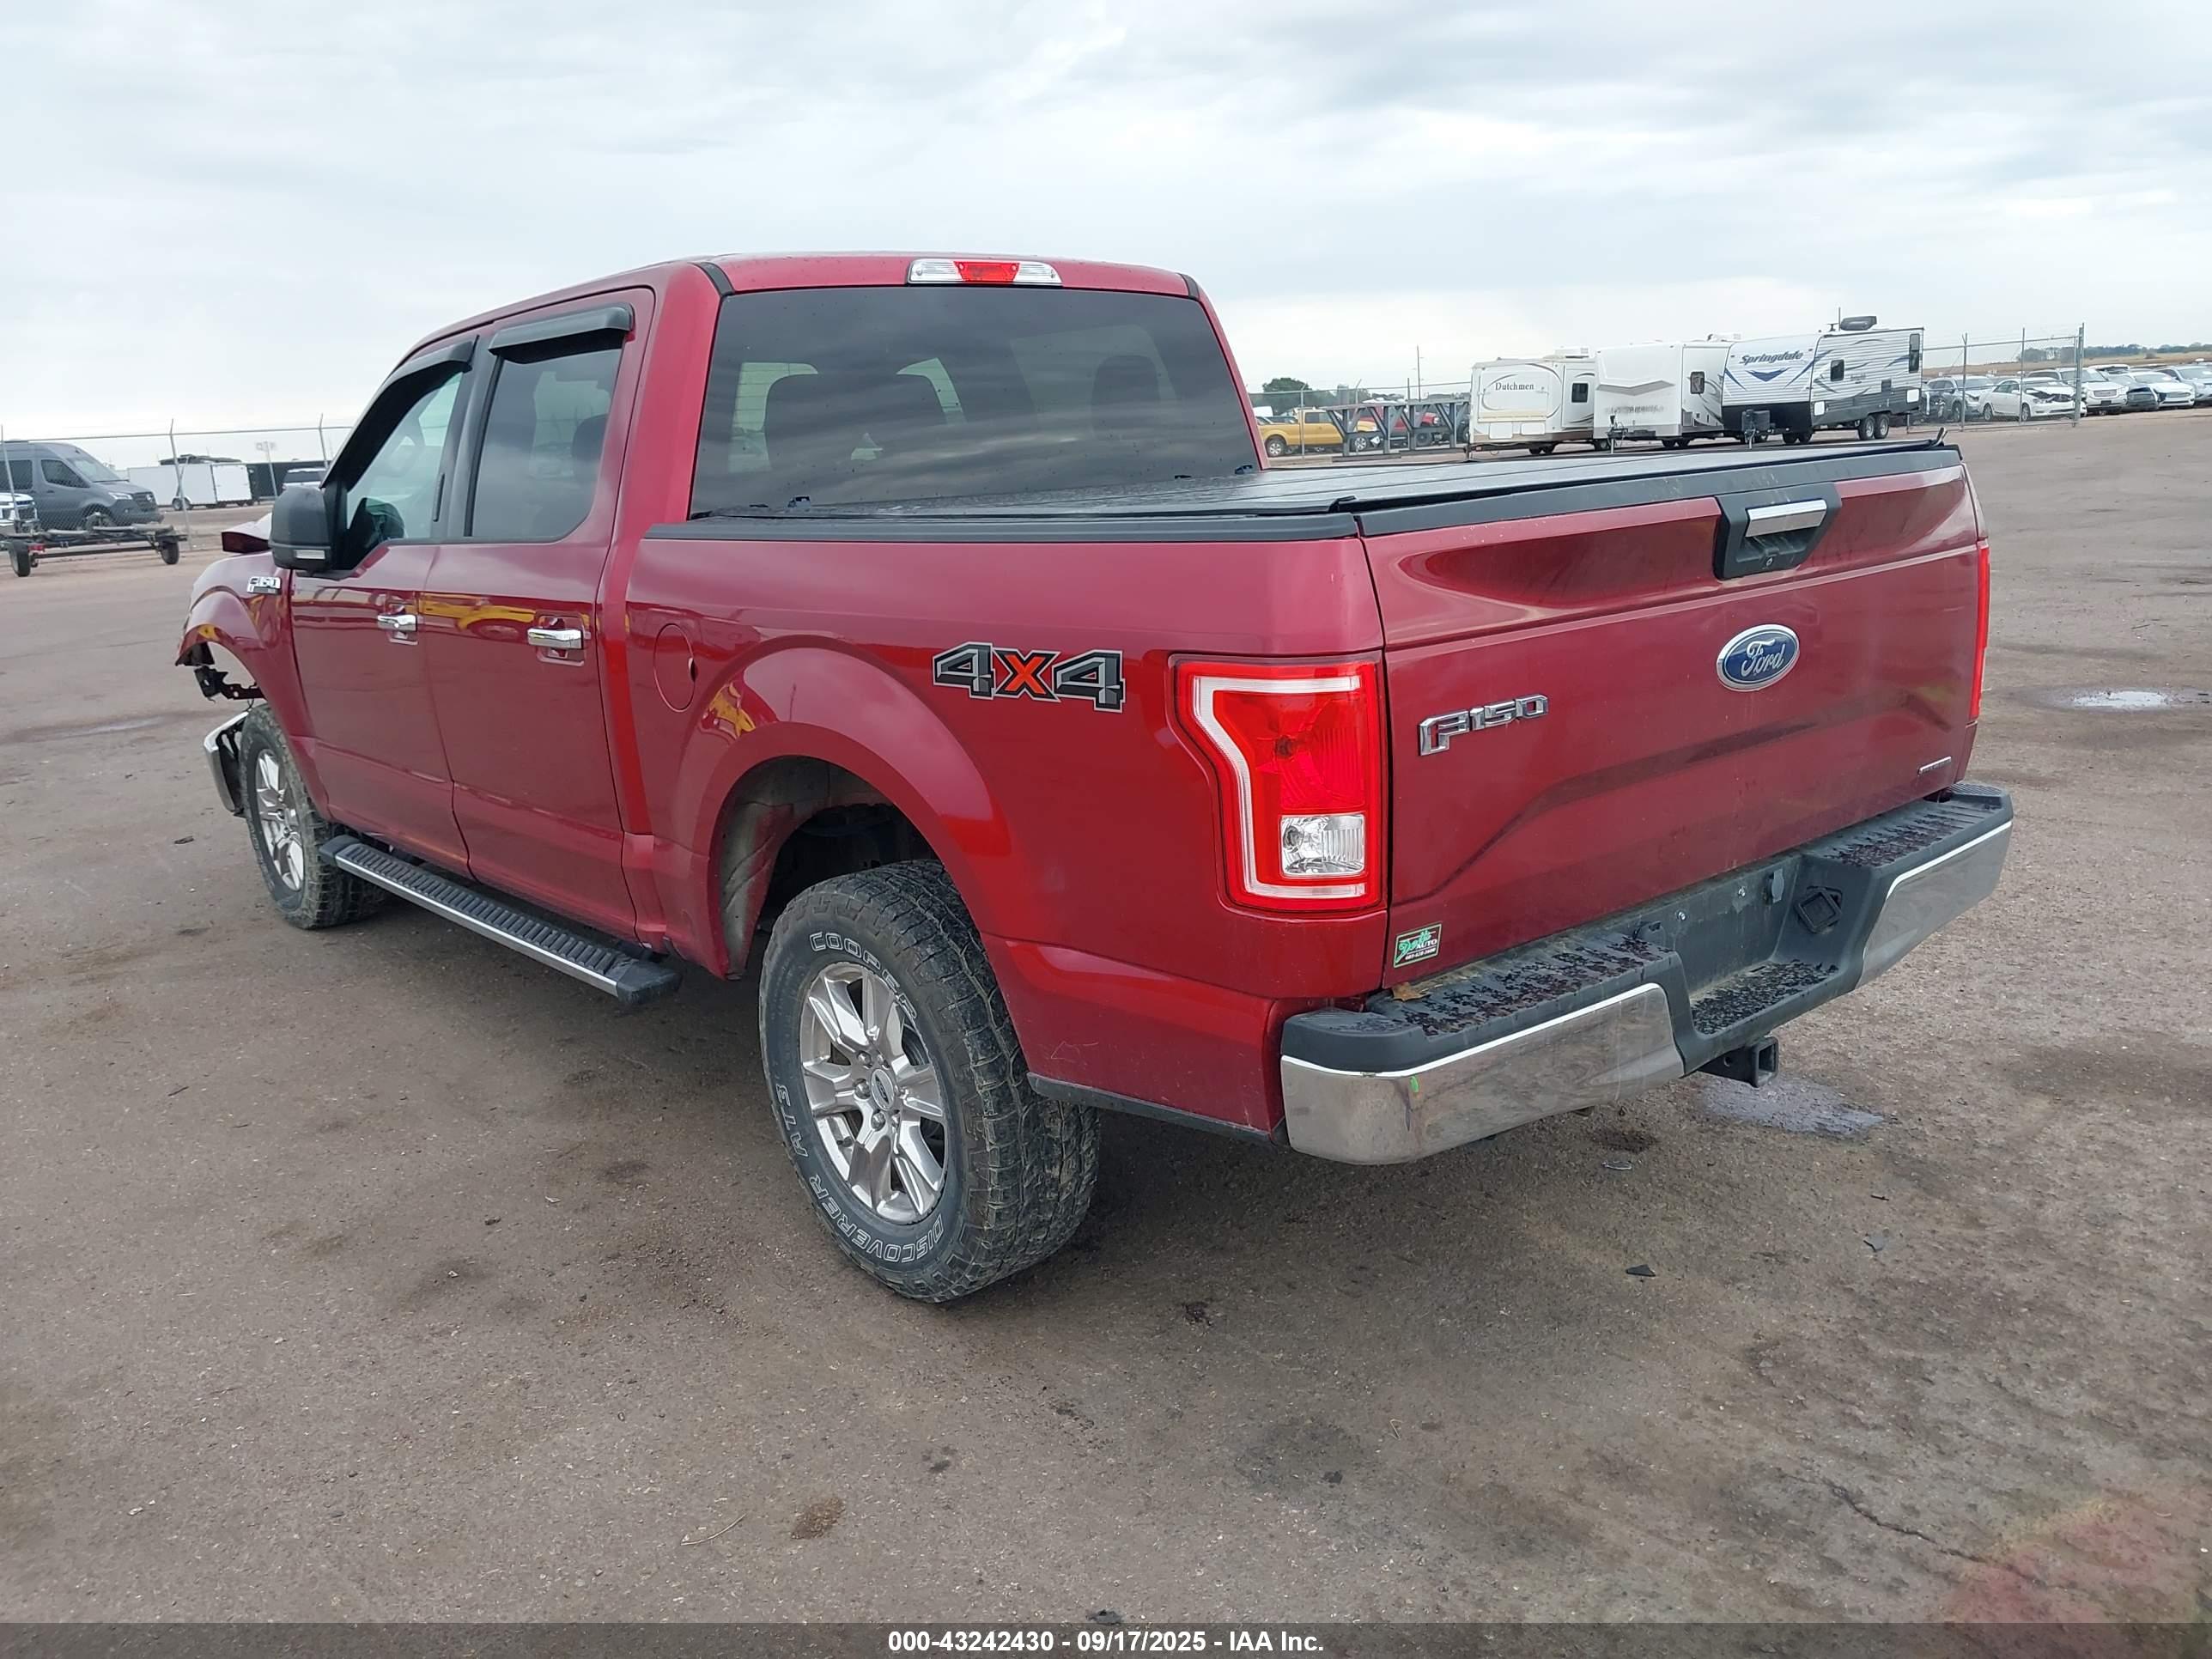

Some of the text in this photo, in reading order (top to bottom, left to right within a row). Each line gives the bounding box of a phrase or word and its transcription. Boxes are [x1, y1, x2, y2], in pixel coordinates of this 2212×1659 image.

[1739, 350, 1803, 366] Springdale
[1495, 382, 1534, 391] Dutchmen
[1741, 639, 1786, 677] Ford
[1415, 939, 1437, 951] AUTO
[810, 932, 917, 1018] COOPER
[809, 1174, 944, 1263] DISCOVERER
